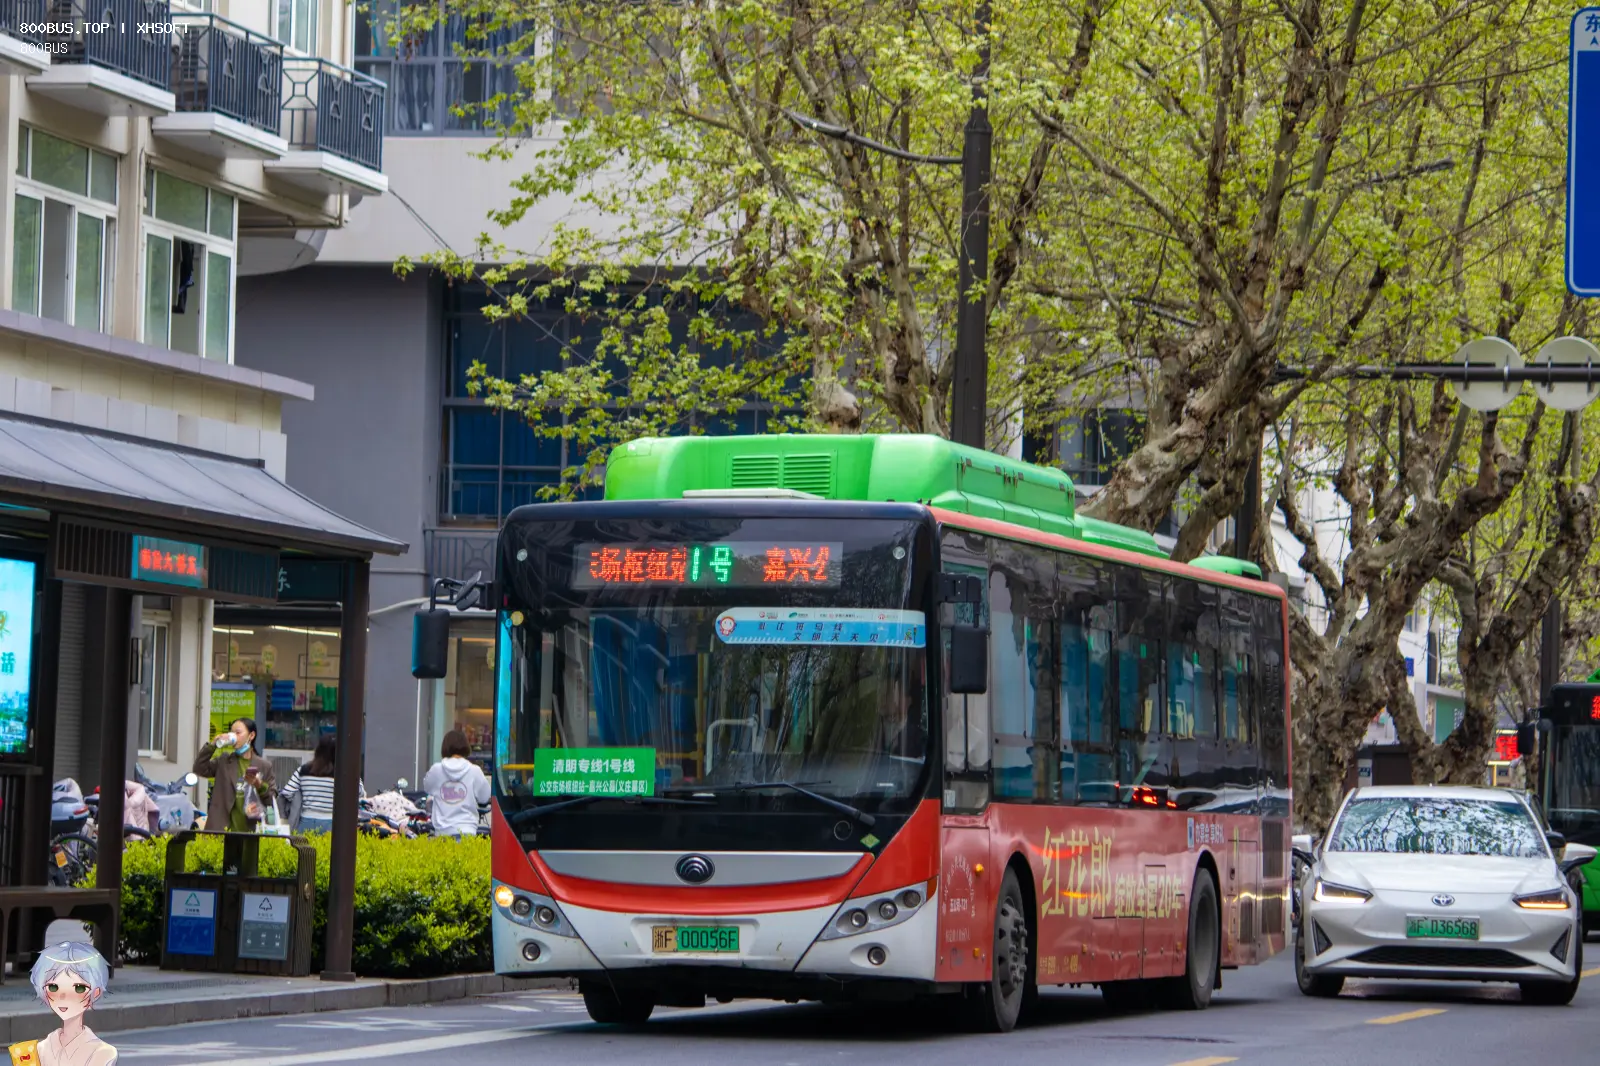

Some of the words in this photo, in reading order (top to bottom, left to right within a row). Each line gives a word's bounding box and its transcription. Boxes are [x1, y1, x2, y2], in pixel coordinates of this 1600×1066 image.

[692, 547, 732, 582] 1号
[552, 758, 636, 774] 清明专线1号线
[1041, 825, 1113, 920] 红花郎
[1431, 919, 1478, 936] D36568
[681, 930, 737, 948] 00056F
